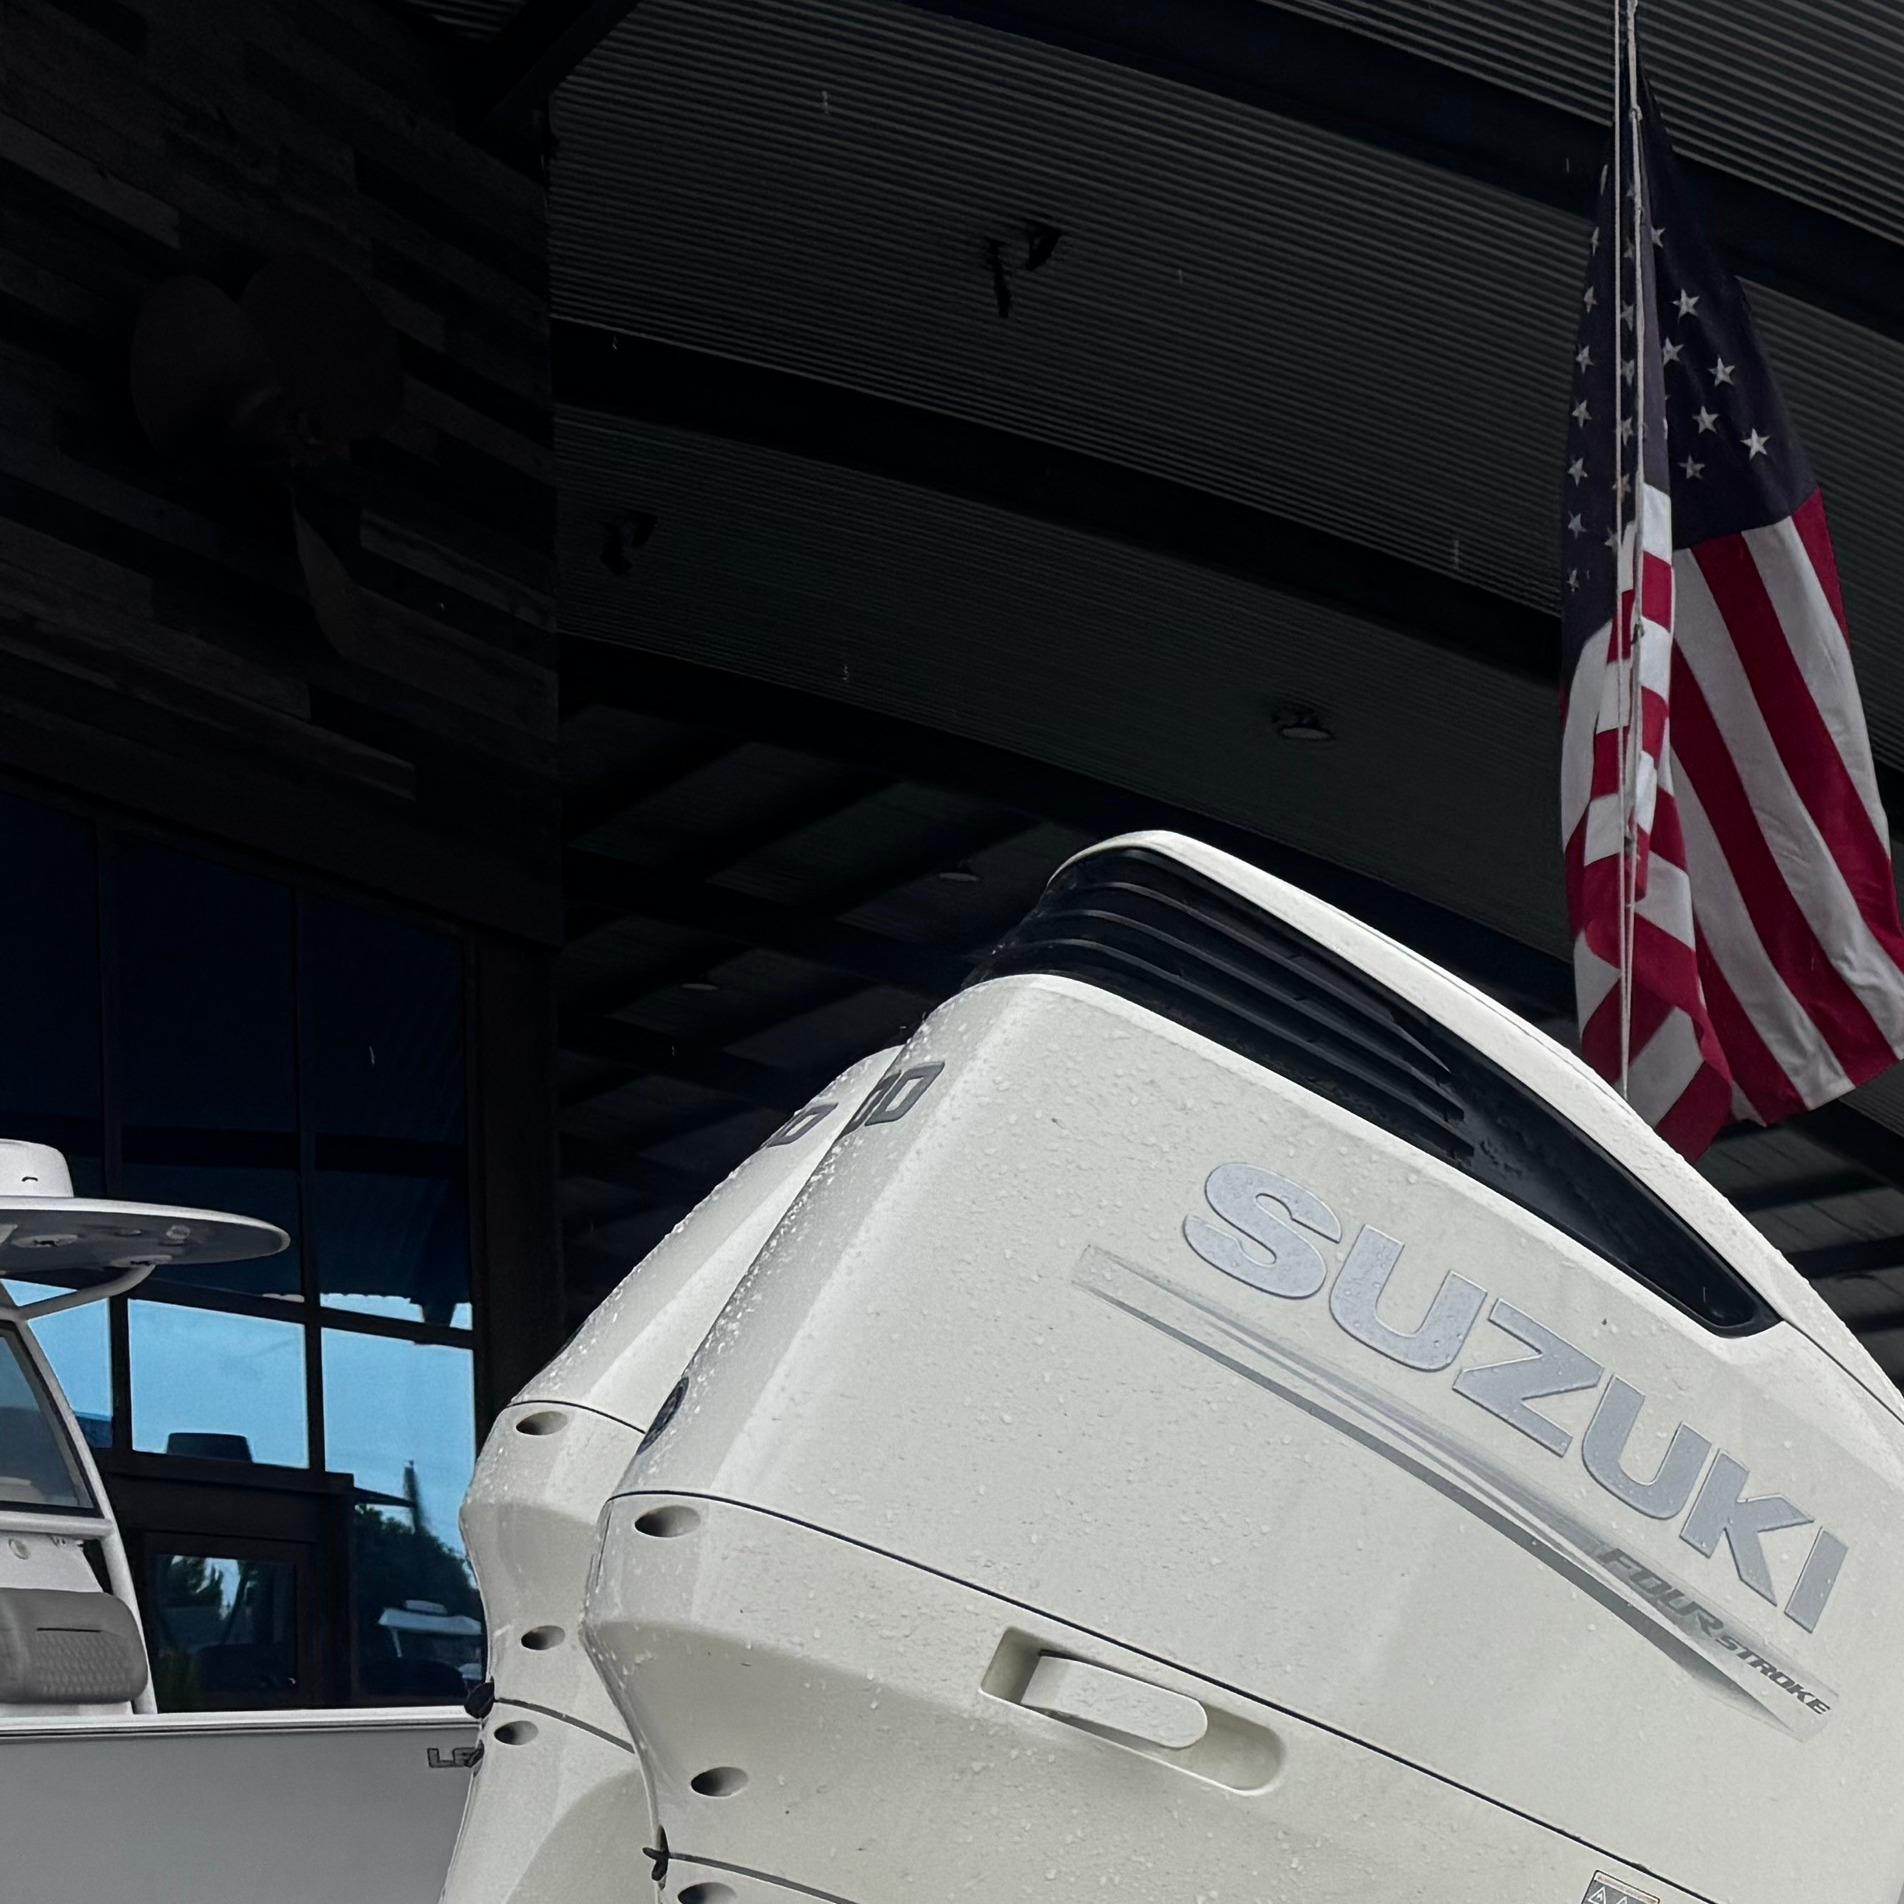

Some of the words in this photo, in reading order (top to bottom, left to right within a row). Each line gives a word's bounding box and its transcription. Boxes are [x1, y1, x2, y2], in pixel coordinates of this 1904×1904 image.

[1181, 1160, 1850, 1634] SUZUKI
[1598, 1547, 1725, 1638] FOUR
[1714, 1634, 1832, 1717] STROKE
